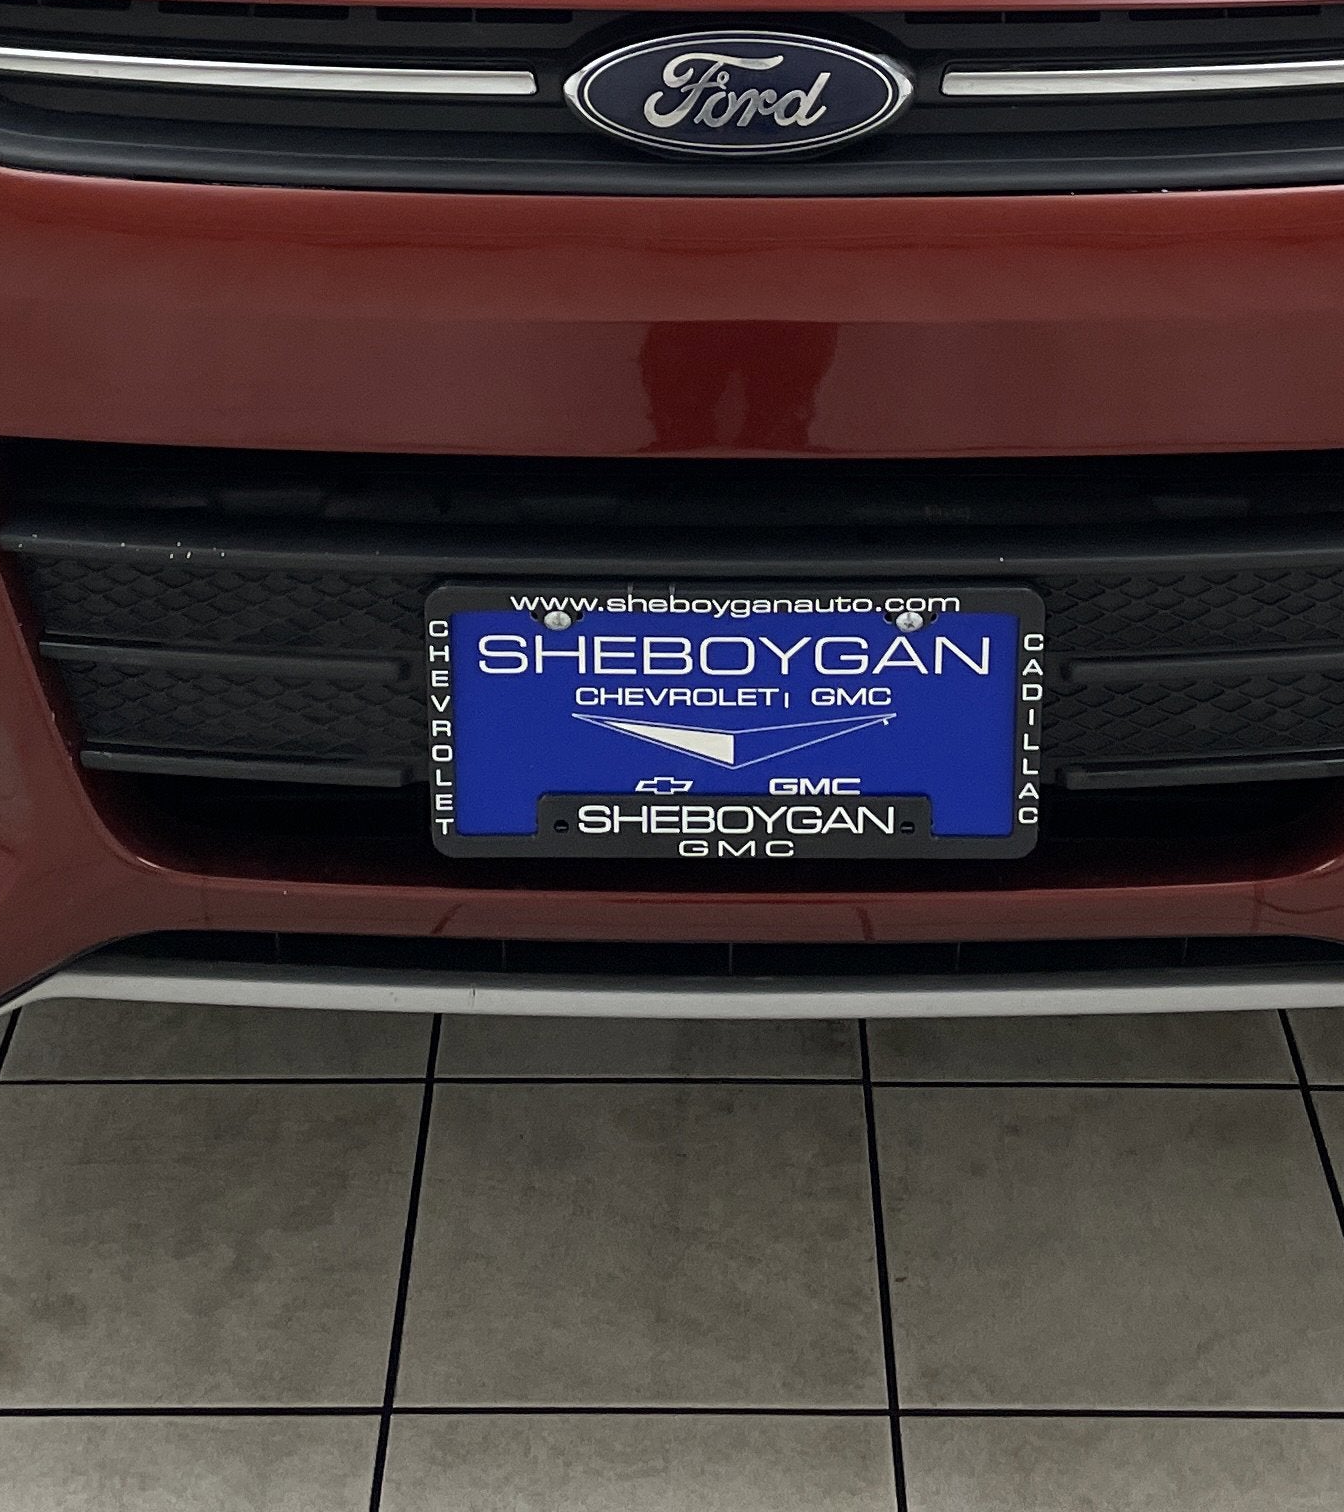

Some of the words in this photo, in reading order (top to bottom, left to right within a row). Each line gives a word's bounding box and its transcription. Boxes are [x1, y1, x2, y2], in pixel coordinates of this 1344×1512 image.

[643, 52, 831, 128] Ford
[510, 595, 961, 619] www.sheboyganauto.com
[478, 634, 990, 676] SHEBOYGAN
[575, 687, 780, 707] CHEVROLET
[811, 687, 892, 706] GMC
[428, 620, 455, 835] CHEVROLET
[1019, 633, 1044, 825] CADILLAC
[768, 778, 861, 796] GMC
[578, 805, 895, 835] SHEBOYGAN
[678, 840, 795, 858] GMC
